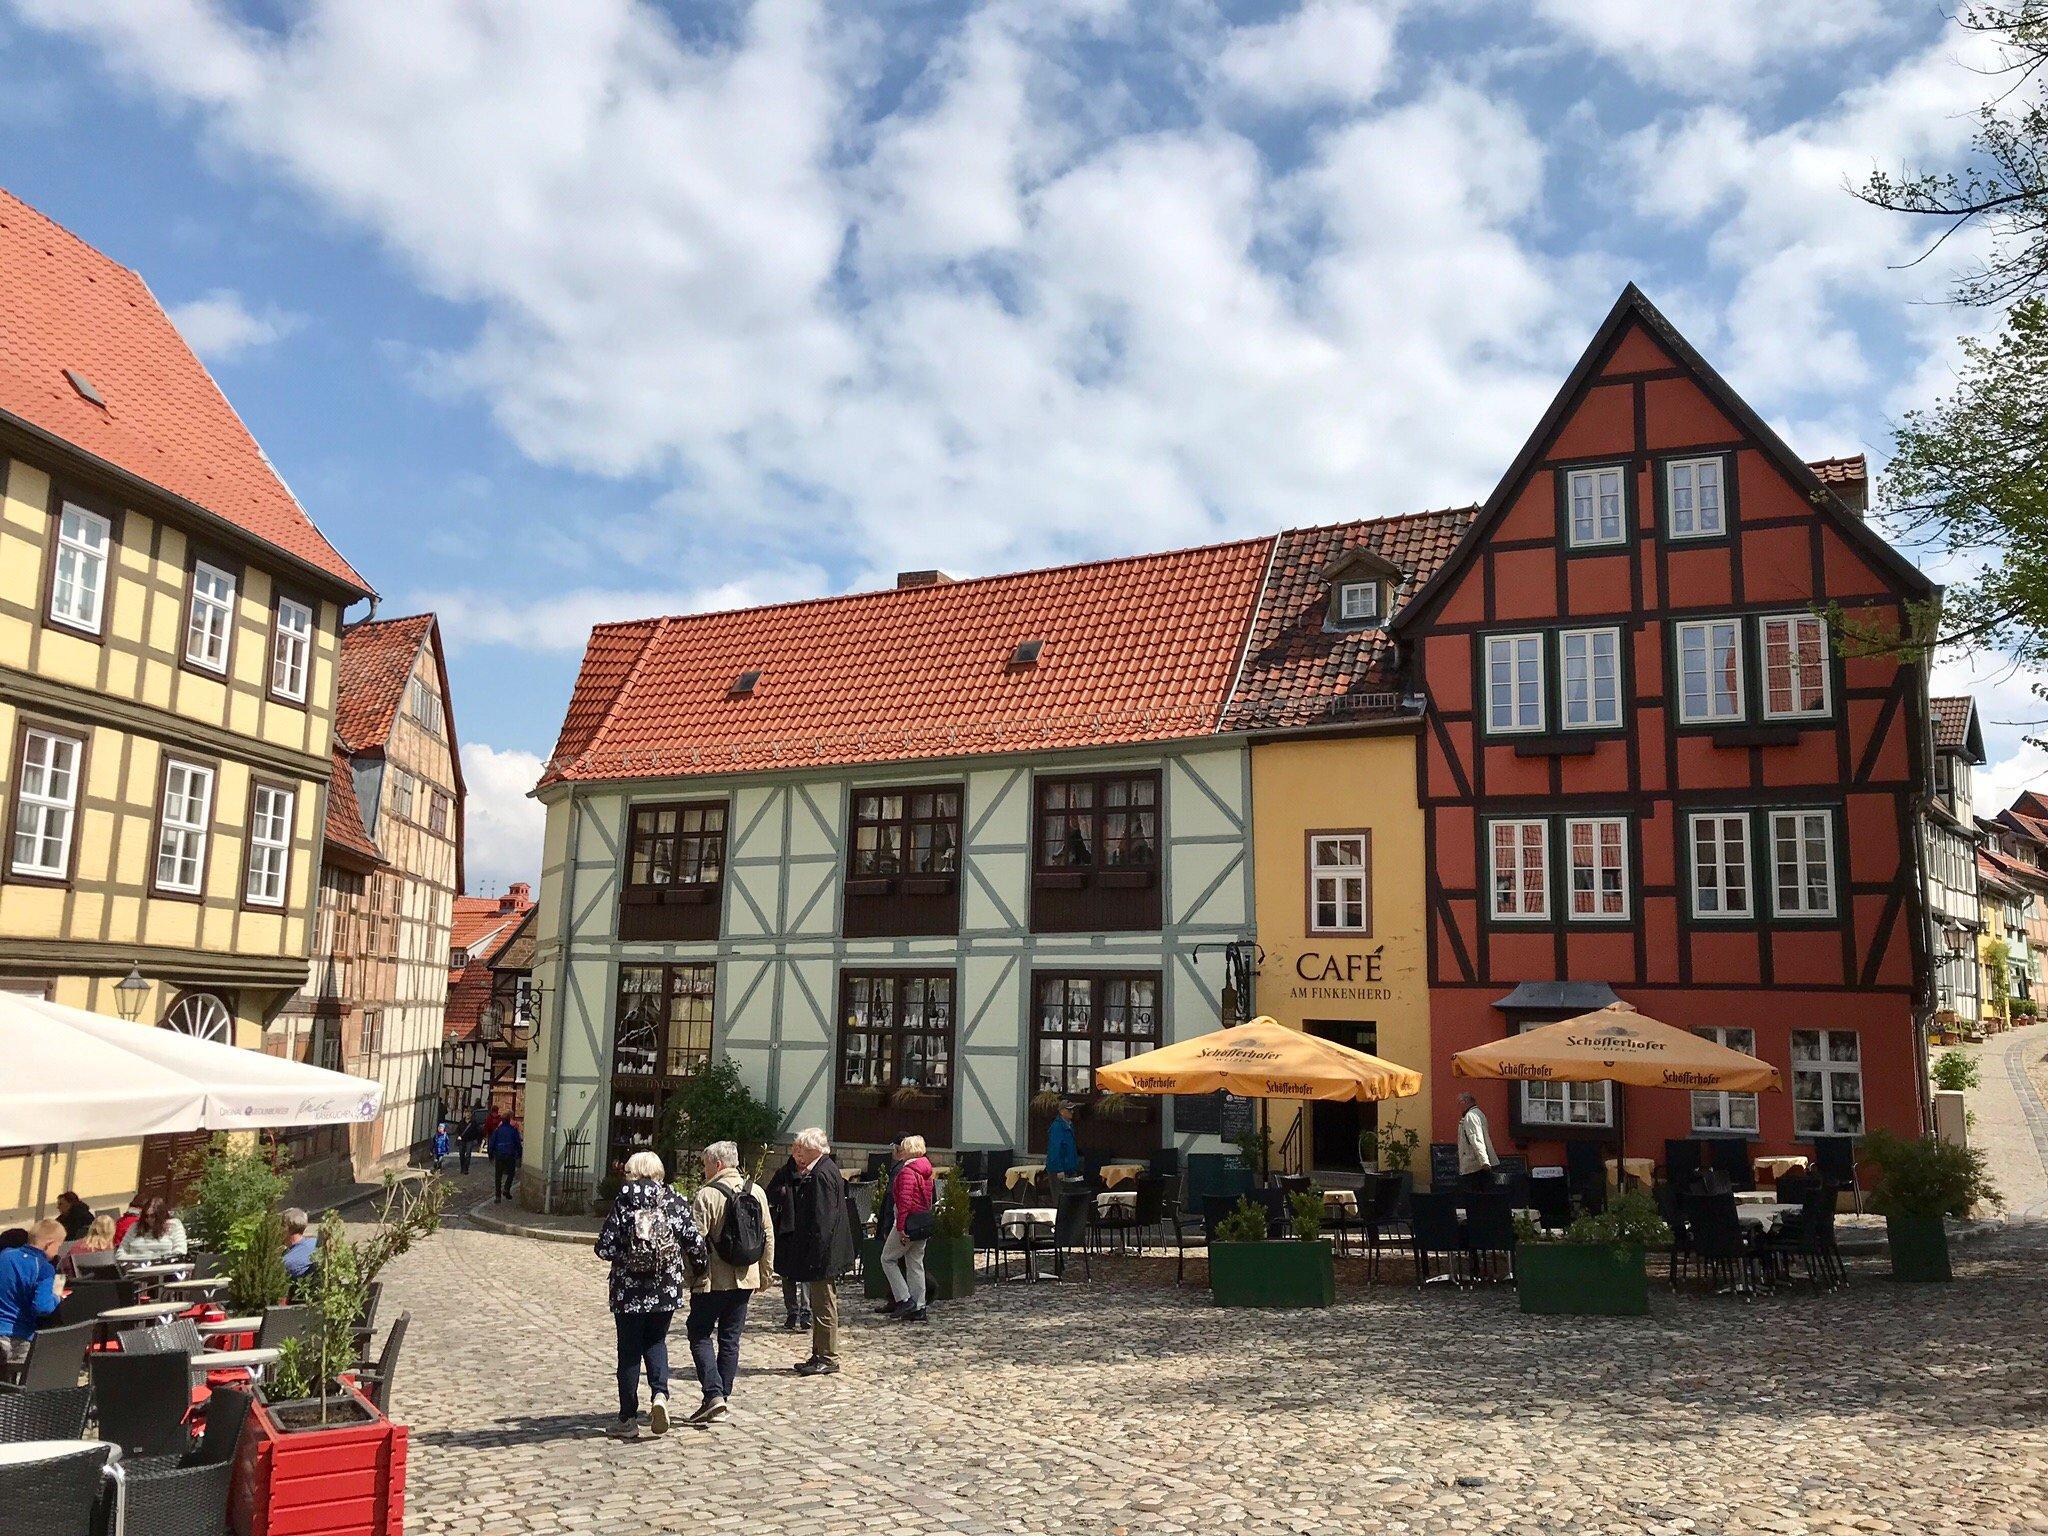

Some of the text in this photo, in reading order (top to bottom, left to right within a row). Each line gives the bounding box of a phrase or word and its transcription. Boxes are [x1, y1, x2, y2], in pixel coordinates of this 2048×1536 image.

[1296, 945, 1384, 982] CAFÉ
[1290, 988, 1391, 1000] AM FINKENHERD
[1565, 1035, 1668, 1051] Schöfferhofer
[1197, 1048, 1282, 1060] Schöfferhofer
[1498, 1061, 1553, 1078] Schöfferhofer
[1662, 1070, 1721, 1086] Schöfferhofer
[1265, 1081, 1314, 1096] Schöfferhofer
